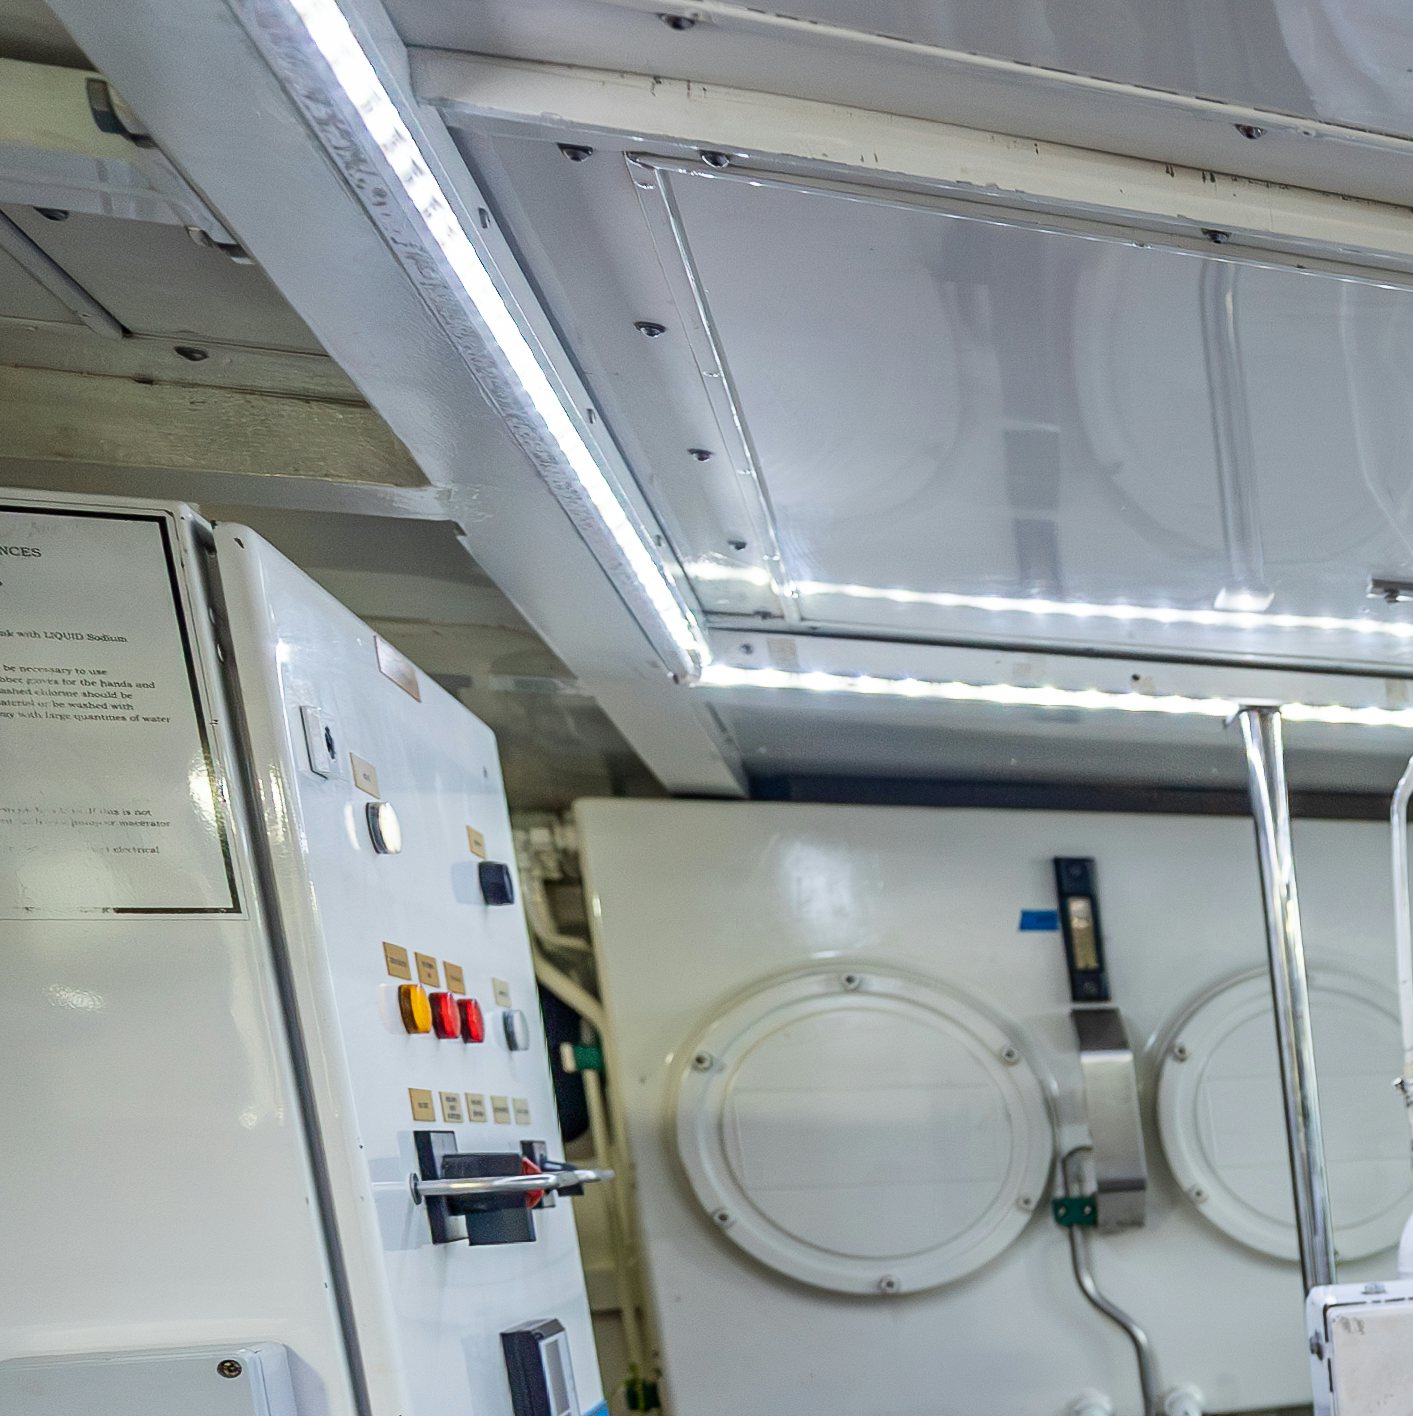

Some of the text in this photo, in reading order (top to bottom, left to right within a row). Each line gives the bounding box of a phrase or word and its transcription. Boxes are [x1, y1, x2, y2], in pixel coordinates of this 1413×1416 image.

[17, 630, 42, 639] with
[44, 631, 84, 641] LIQUID
[87, 633, 128, 643] Sodium
[3, 664, 16, 672] be
[80, 679, 97, 687] the
[100, 679, 133, 688] hands
[135, 681, 155, 689] and
[82, 690, 117, 699] should
[120, 692, 133, 700] be
[52, 700, 65, 709] be
[66, 702, 108, 710] washed
[111, 703, 134, 711] with
[129, 714, 140, 722] of
[142, 715, 171, 723] water
